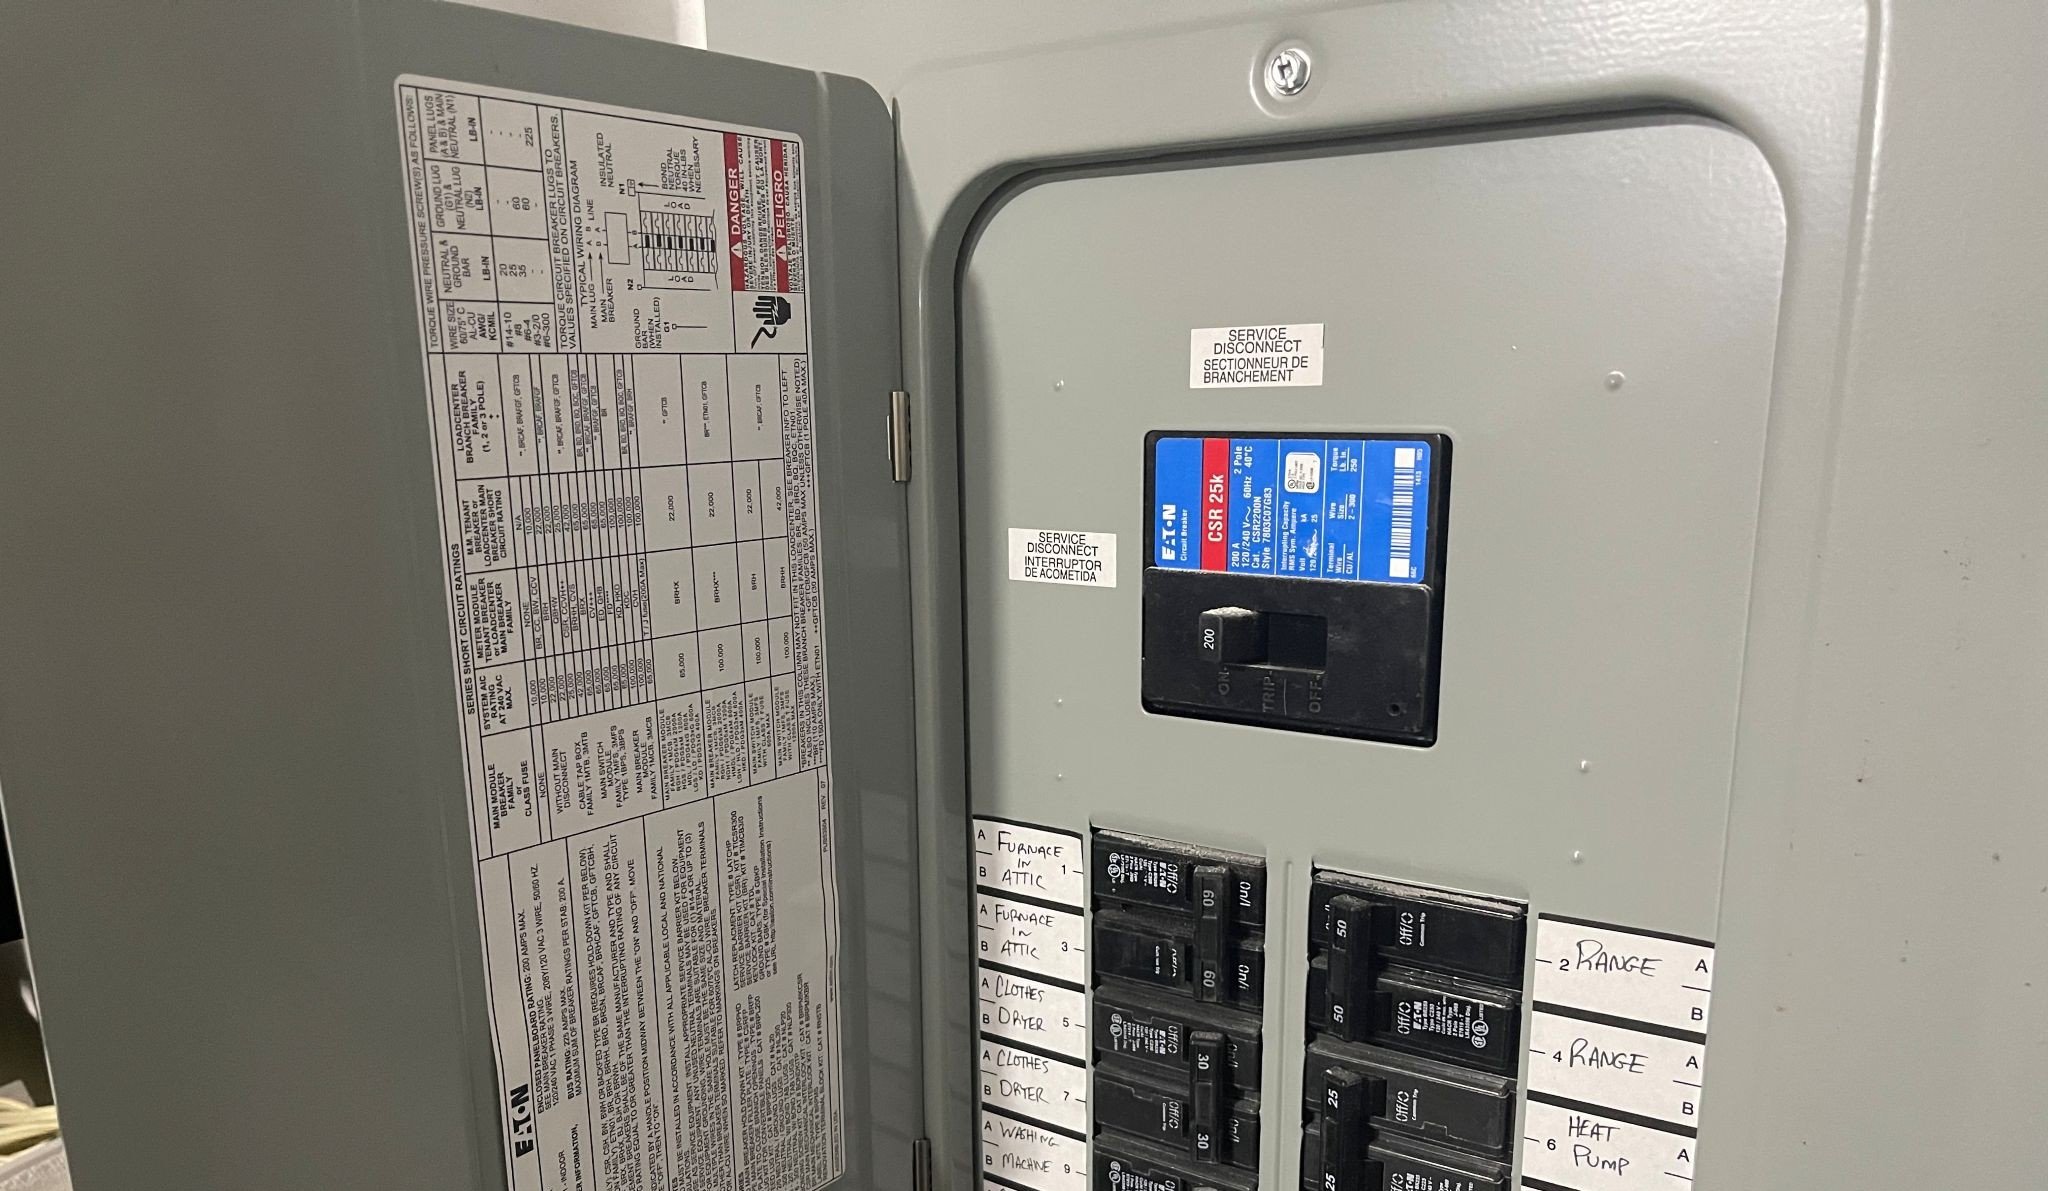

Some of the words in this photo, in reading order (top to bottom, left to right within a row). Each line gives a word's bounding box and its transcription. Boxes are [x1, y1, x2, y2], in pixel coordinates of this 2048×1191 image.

[468, 118, 478, 141] LB-IN
[524, 127, 534, 147] 225
[544, 149, 552, 164] TO
[550, 114, 563, 177] BREAKERS.
[411, 151, 419, 165] AS
[412, 167, 424, 218] SCREW(S)
[546, 168, 555, 198] LUGS
[570, 160, 581, 213] DIAGRAM
[474, 187, 483, 210] LB-IN
[512, 197, 520, 210] 60
[522, 198, 530, 210] 60
[556, 180, 566, 225] CIRCUIT
[728, 168, 740, 235] DANGER
[774, 170, 786, 238] PELIGRO
[549, 199, 560, 254] BREAKER
[560, 229, 568, 244] ON
[574, 216, 585, 258] WIRING
[418, 222, 430, 275] PRESSURE
[442, 249, 452, 293] NEUTRAL
[450, 246, 462, 288] GROUND
[461, 258, 471, 277] BAR
[481, 256, 490, 280] LB-IN
[499, 264, 508, 276] 20
[509, 264, 517, 277] 25
[519, 264, 526, 277] 35
[561, 248, 574, 304] SPECIFIED
[554, 258, 565, 300] CIRCUIT
[578, 261, 588, 306] TYPICAL
[424, 279, 434, 304] WIRE
[427, 307, 439, 348] TORQUE
[467, 312, 477, 340] AL-CU
[488, 312, 496, 340] KCMIL
[504, 312, 513, 348] #14-10
[514, 324, 522, 336] #8
[558, 304, 568, 348] TORQUE
[566, 308, 576, 349] VALUES
[1228, 327, 1287, 341] SERVICE
[1213, 340, 1302, 355] DISCONNECT
[1203, 357, 1288, 371] SECTIONNEUR
[1291, 356, 1309, 368] DE
[1203, 369, 1294, 384] BRANCHEMENT
[459, 370, 470, 419] BREAKER
[451, 384, 464, 451] LOADCENTER
[470, 398, 479, 435] FAMILY
[464, 422, 474, 464] BRANCH
[1233, 446, 1243, 467] Pole
[1244, 445, 1253, 468] 40°C
[1331, 447, 1339, 472] Torque
[1350, 458, 1358, 472] 250
[1208, 474, 1224, 503] 25k
[1243, 476, 1252, 498] 60Hz
[1207, 508, 1223, 542] CSR
[1252, 496, 1261, 543] CSR2200N
[1262, 487, 1272, 543] 7803C07G83
[1282, 501, 1290, 530] Capacity
[1311, 514, 1317, 523] 25
[1038, 531, 1086, 546] SERVICE
[1161, 504, 1176, 561] EATON
[1027, 542, 1099, 557] DISCONNECT
[1180, 538, 1188, 561] Circuit
[1231, 550, 1240, 567] 200
[1242, 530, 1251, 568] 120/240
[1251, 551, 1260, 568] Cat.
[1261, 547, 1271, 569] Style
[1281, 531, 1289, 570] Interrupting
[1327, 543, 1335, 573] Terminal
[452, 544, 463, 590] RATINGS
[1024, 555, 1102, 572] INTERRUPTOR
[1024, 566, 1038, 578] DE
[1039, 568, 1097, 583] ACOMETIDA
[1346, 552, 1354, 575] CU/AL
[456, 594, 468, 636] CIRCUIT
[1203, 628, 1215, 650] 200
[460, 636, 472, 674] SHORT
[465, 678, 475, 714] SERIES
[1262, 676, 1276, 713] TRIP
[1309, 681, 1322, 713] OFF
[521, 760, 529, 784] FUSE
[488, 764, 498, 804] MODULE
[498, 772, 507, 816] BREAKER
[506, 776, 516, 809] FAMILY
[516, 786, 522, 795] or
[524, 786, 532, 816] CLASS
[492, 806, 500, 829] MAIN
[978, 829, 986, 840] A
[998, 830, 1064, 859] FURNACE
[979, 866, 987, 877] B
[1018, 858, 1031, 869] IN
[1061, 865, 1066, 875] 1
[1001, 869, 1047, 890] ATTIC
[980, 904, 988, 915] A
[1202, 889, 1215, 907] 60
[518, 909, 526, 930] MAX.
[995, 904, 1055, 928] FURNACE
[1012, 926, 1032, 937] IN
[1336, 919, 1347, 938] 50
[520, 932, 529, 956] AMPS
[981, 941, 988, 951] B
[1001, 939, 1040, 960] ATTIC
[1061, 942, 1068, 952] 3
[522, 958, 530, 972] 200
[1559, 958, 1570, 972] 2
[1576, 939, 1663, 978] RANGE
[1695, 958, 1708, 974] A
[981, 977, 989, 988] A
[995, 975, 1045, 1003] CLOTHES
[1203, 970, 1216, 988] 60
[524, 974, 535, 1008] RATING:
[983, 1013, 990, 1024] B
[998, 1006, 1047, 1032] DRYER
[1062, 1017, 1070, 1028] 5
[1333, 1005, 1344, 1024] 50
[1691, 1006, 1704, 1021] B
[529, 1011, 541, 1067] PANELBOARD
[983, 1050, 991, 1061] A
[996, 1049, 1049, 1074] CLOTHES
[1197, 1053, 1210, 1070] 30
[1552, 1050, 1563, 1063] 4
[1569, 1037, 1649, 1074] RANGE
[1686, 1055, 1700, 1069] A
[534, 1070, 544, 1114] ENCLOSED
[984, 1085, 991, 1095] B
[999, 1079, 1050, 1104] DRYER
[1064, 1091, 1070, 1101] 7
[1328, 1088, 1339, 1108] 25
[1682, 1101, 1695, 1115] B
[510, 1084, 534, 1158] EATON
[984, 1120, 992, 1131] A
[1568, 1115, 1621, 1142] HEAT
[999, 1121, 1060, 1147] WASHING
[1197, 1133, 1209, 1150] 30
[1546, 1138, 1557, 1151] 6
[985, 1154, 993, 1165] B
[1002, 1152, 1052, 1173] MACHINE
[1677, 1148, 1690, 1163] A
[1325, 1173, 1336, 1191] 25
